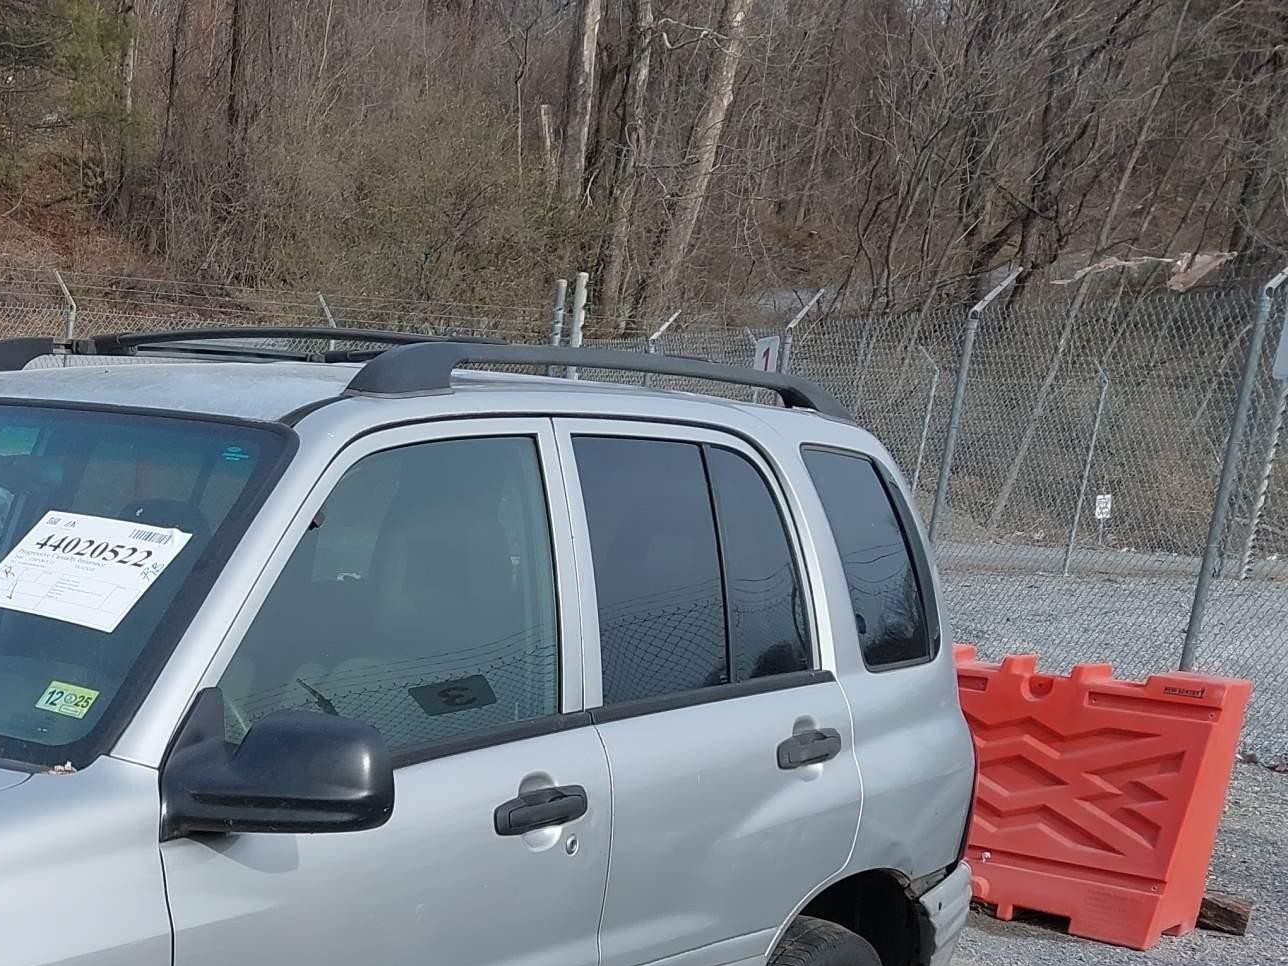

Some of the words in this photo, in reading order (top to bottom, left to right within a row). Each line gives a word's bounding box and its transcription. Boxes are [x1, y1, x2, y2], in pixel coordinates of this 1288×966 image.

[35, 533, 153, 568] 44020522
[44, 688, 65, 706] 12
[73, 694, 93, 709] 25
